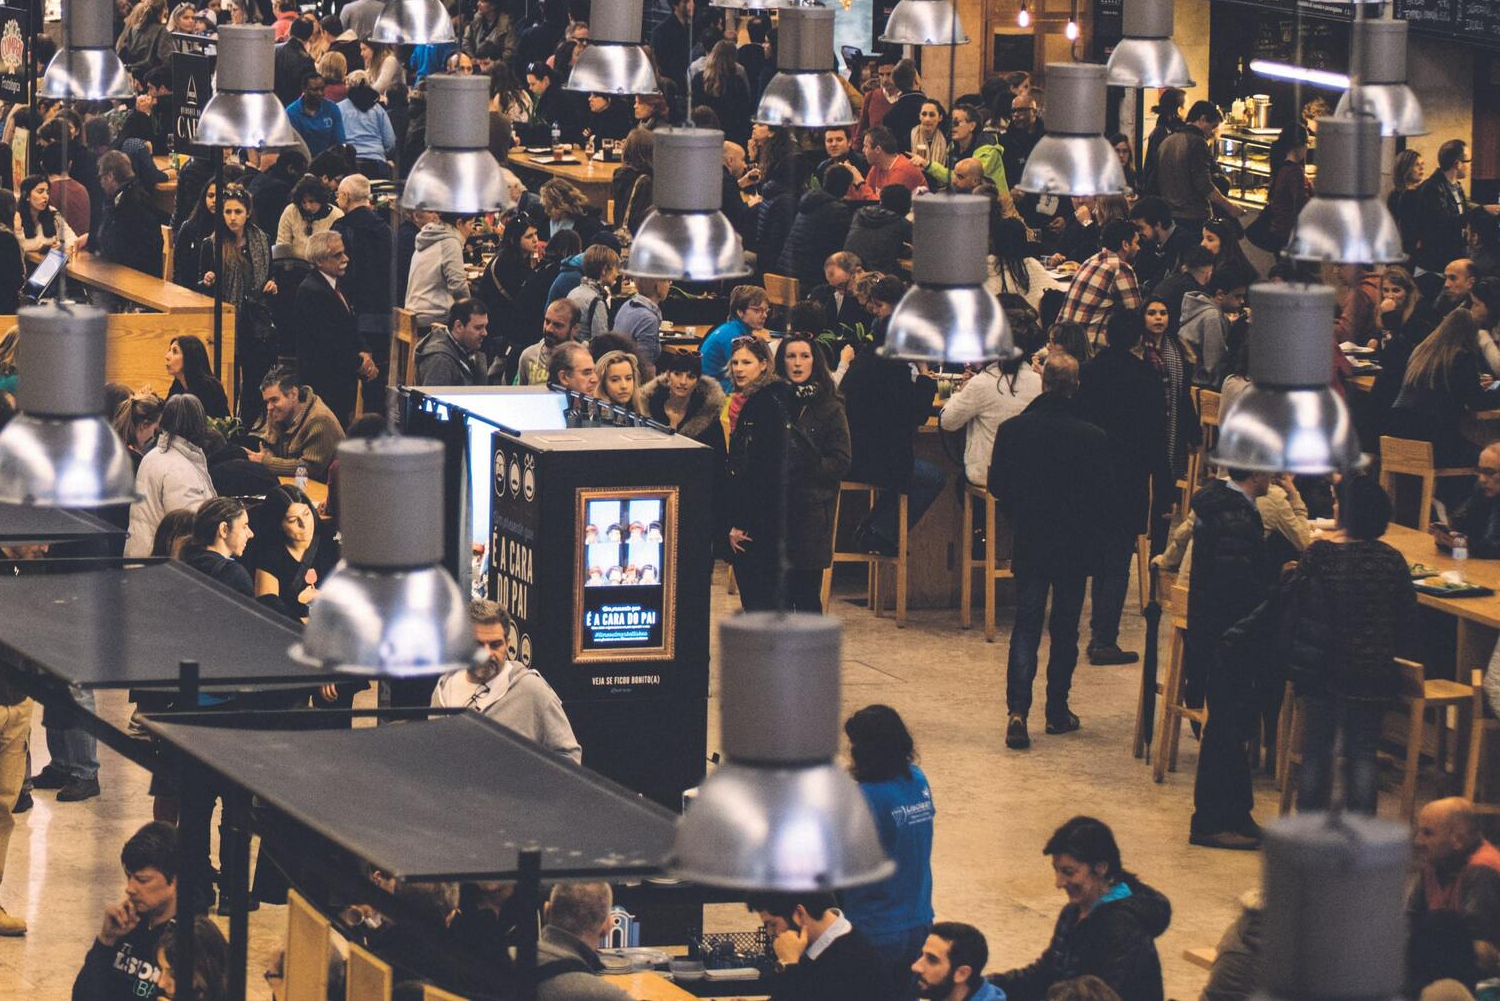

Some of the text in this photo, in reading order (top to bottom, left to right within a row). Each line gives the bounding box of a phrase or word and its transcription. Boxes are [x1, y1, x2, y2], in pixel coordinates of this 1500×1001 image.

[177, 115, 200, 140] CAF
[492, 525, 498, 567] É
[500, 536, 506, 572] A
[509, 540, 533, 585] CARA
[497, 572, 528, 620] DO PAI
[586, 611, 656, 626] É A CARA DO PAI
[592, 674, 660, 686] VEJA SE FICOU BONITO(A)
